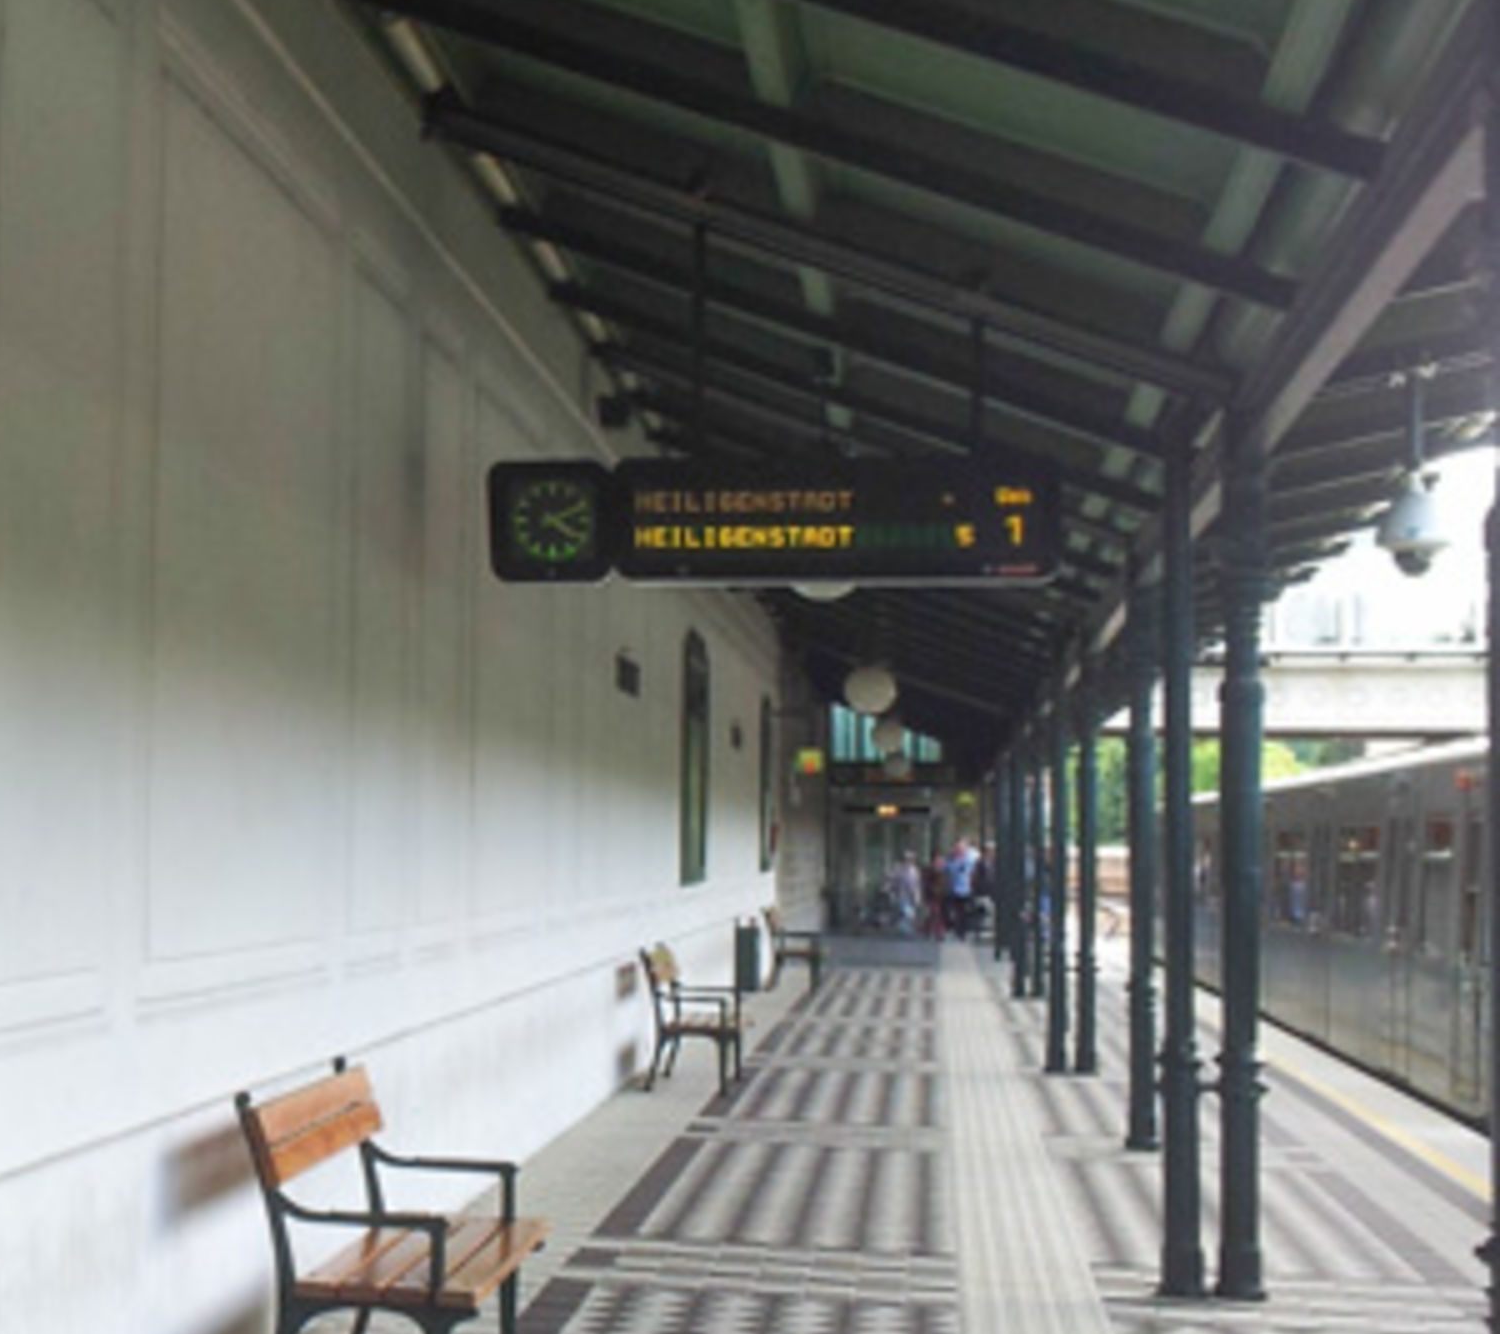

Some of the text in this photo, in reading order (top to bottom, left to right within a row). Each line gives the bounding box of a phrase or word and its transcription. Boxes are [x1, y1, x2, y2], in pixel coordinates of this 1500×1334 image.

[634, 490, 853, 513] HEILIGENSTADT
[634, 525, 853, 548] HEILIGENSTADT
[1004, 514, 1023, 546] 1
